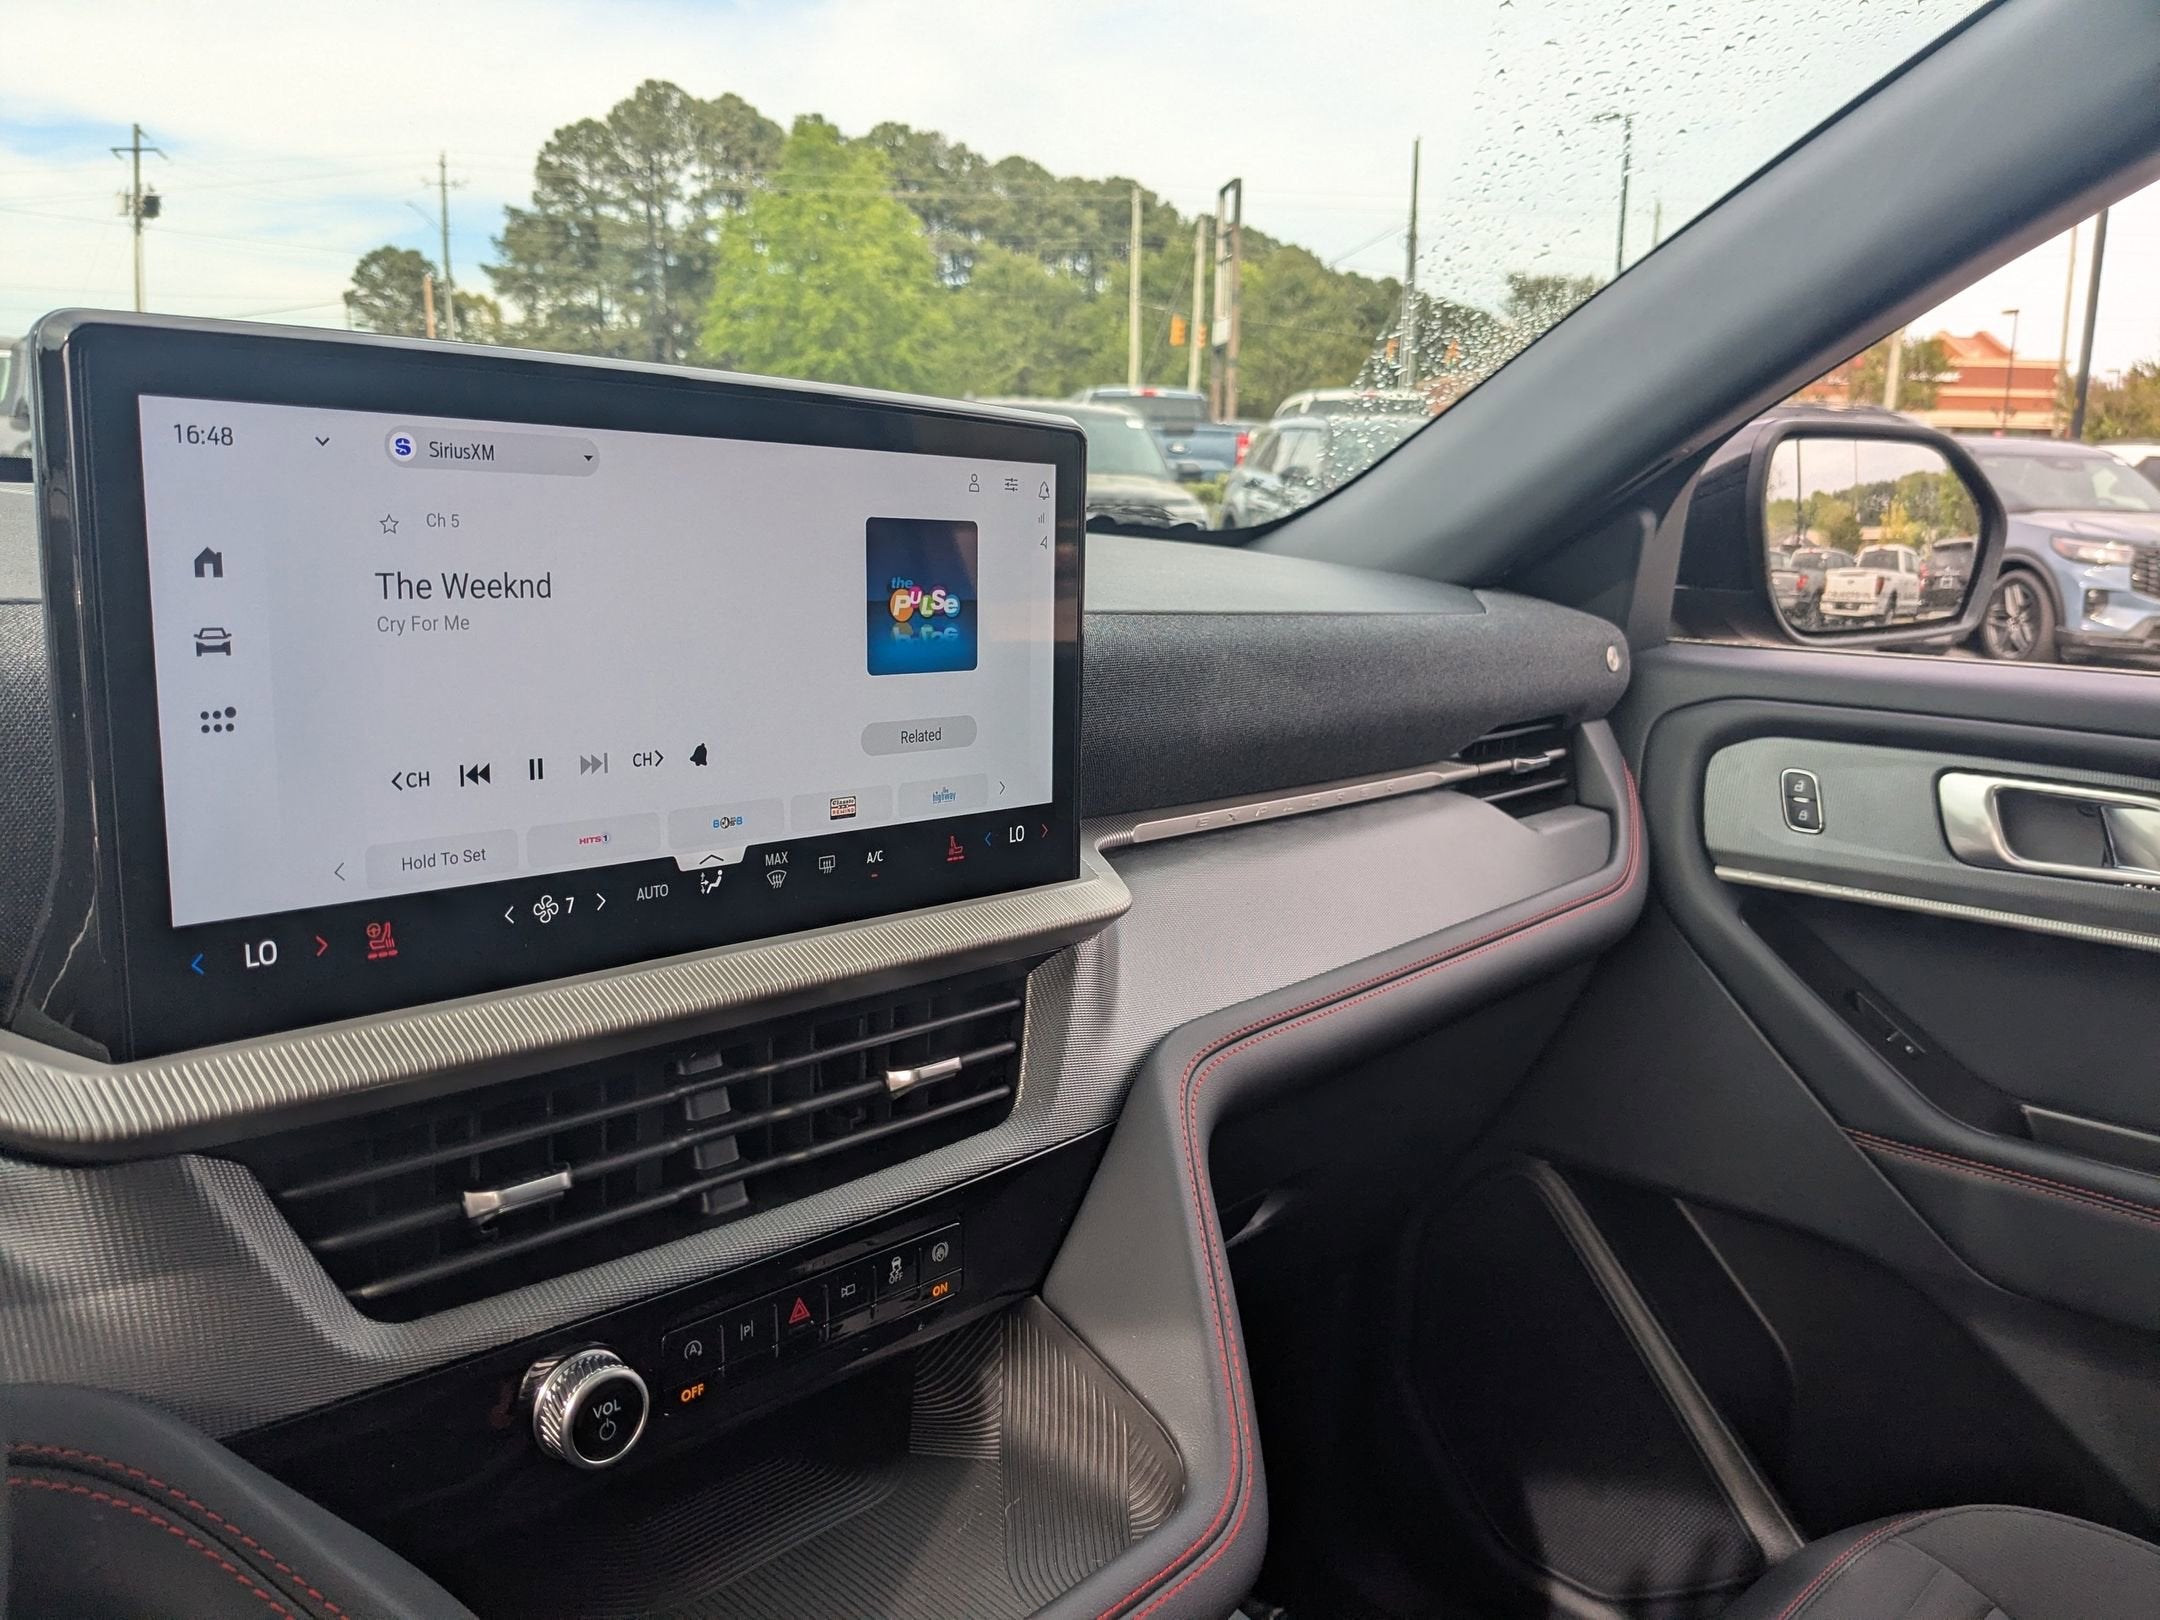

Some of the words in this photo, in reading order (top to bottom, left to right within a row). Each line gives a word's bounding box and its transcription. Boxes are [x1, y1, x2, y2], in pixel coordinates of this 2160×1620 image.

[173, 423, 234, 447] 16:48
[428, 440, 496, 462] SiriusXM
[425, 512, 447, 528] Ch
[450, 513, 460, 528] 5
[374, 570, 433, 600] The
[441, 570, 552, 600] Weeknd
[890, 576, 914, 589] the
[376, 615, 406, 636] Cry
[411, 615, 439, 633] For
[443, 615, 470, 632] Me
[900, 727, 942, 745] Related
[1195, 784, 1394, 828] EXPLORER
[1009, 825, 1025, 843] LO
[401, 852, 437, 872] Hold
[441, 851, 459, 867] To
[463, 849, 486, 865] Set
[765, 852, 789, 866] MAX
[866, 850, 883, 864] A/C
[636, 883, 669, 901] AUTO
[565, 896, 575, 914] 7
[244, 940, 278, 968] LO
[888, 1270, 904, 1285] OFF
[932, 1281, 949, 1298] ON
[680, 1382, 705, 1402] OFF
[592, 1399, 621, 1418] VOL
